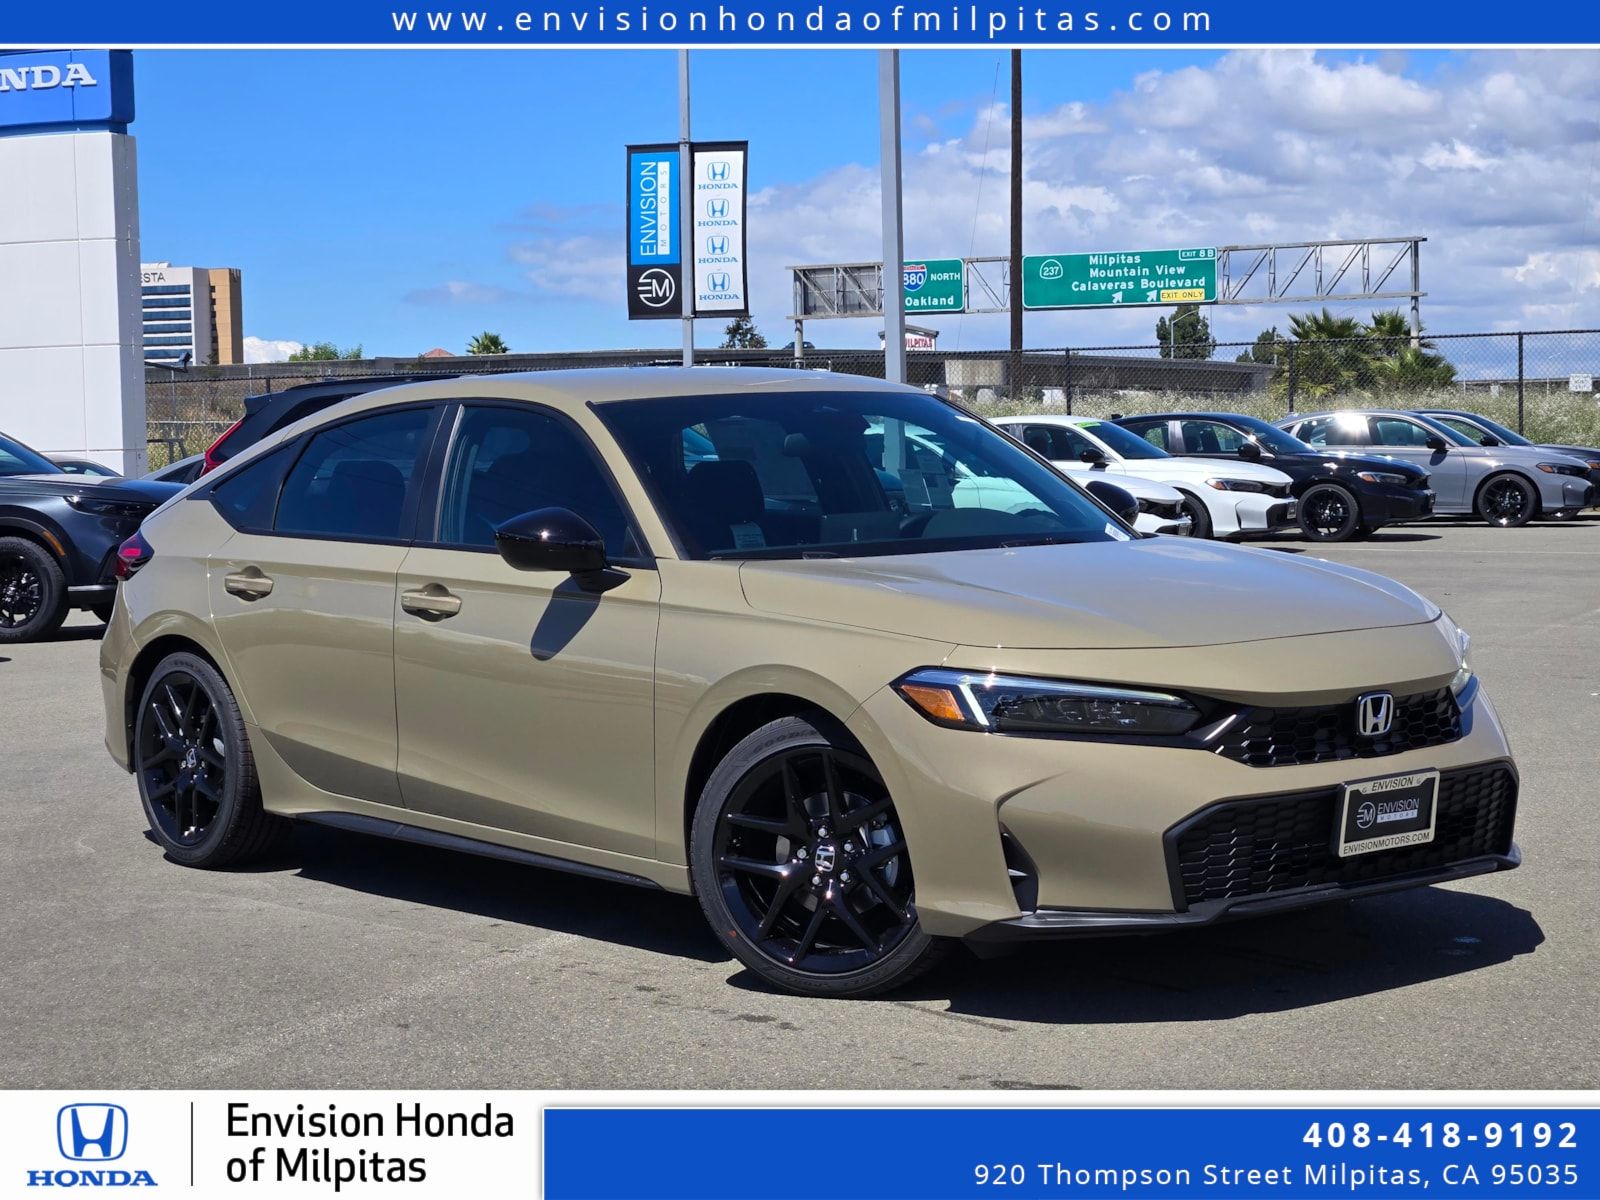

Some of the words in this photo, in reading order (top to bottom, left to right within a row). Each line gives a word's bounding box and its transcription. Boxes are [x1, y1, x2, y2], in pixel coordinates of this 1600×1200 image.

[640, 161, 657, 256] ENVISION
[698, 256, 739, 264] HONDA
[1089, 253, 1141, 266] Milpitas
[1182, 250, 1197, 258] EXIT
[930, 272, 961, 281] NORTH
[1043, 266, 1060, 276] 237
[1089, 266, 1149, 278] Mountain
[1155, 265, 1186, 276] View
[140, 272, 166, 284] STA
[1071, 279, 1134, 292] Calaveras
[1140, 276, 1206, 290] Boulevard
[699, 293, 740, 301] HONDA
[905, 295, 954, 307] Oakland
[1371, 776, 1414, 792] ENVISION
[1377, 798, 1420, 815] ENVISION
[1343, 831, 1430, 855] ENVISIONMOTORS.COM
